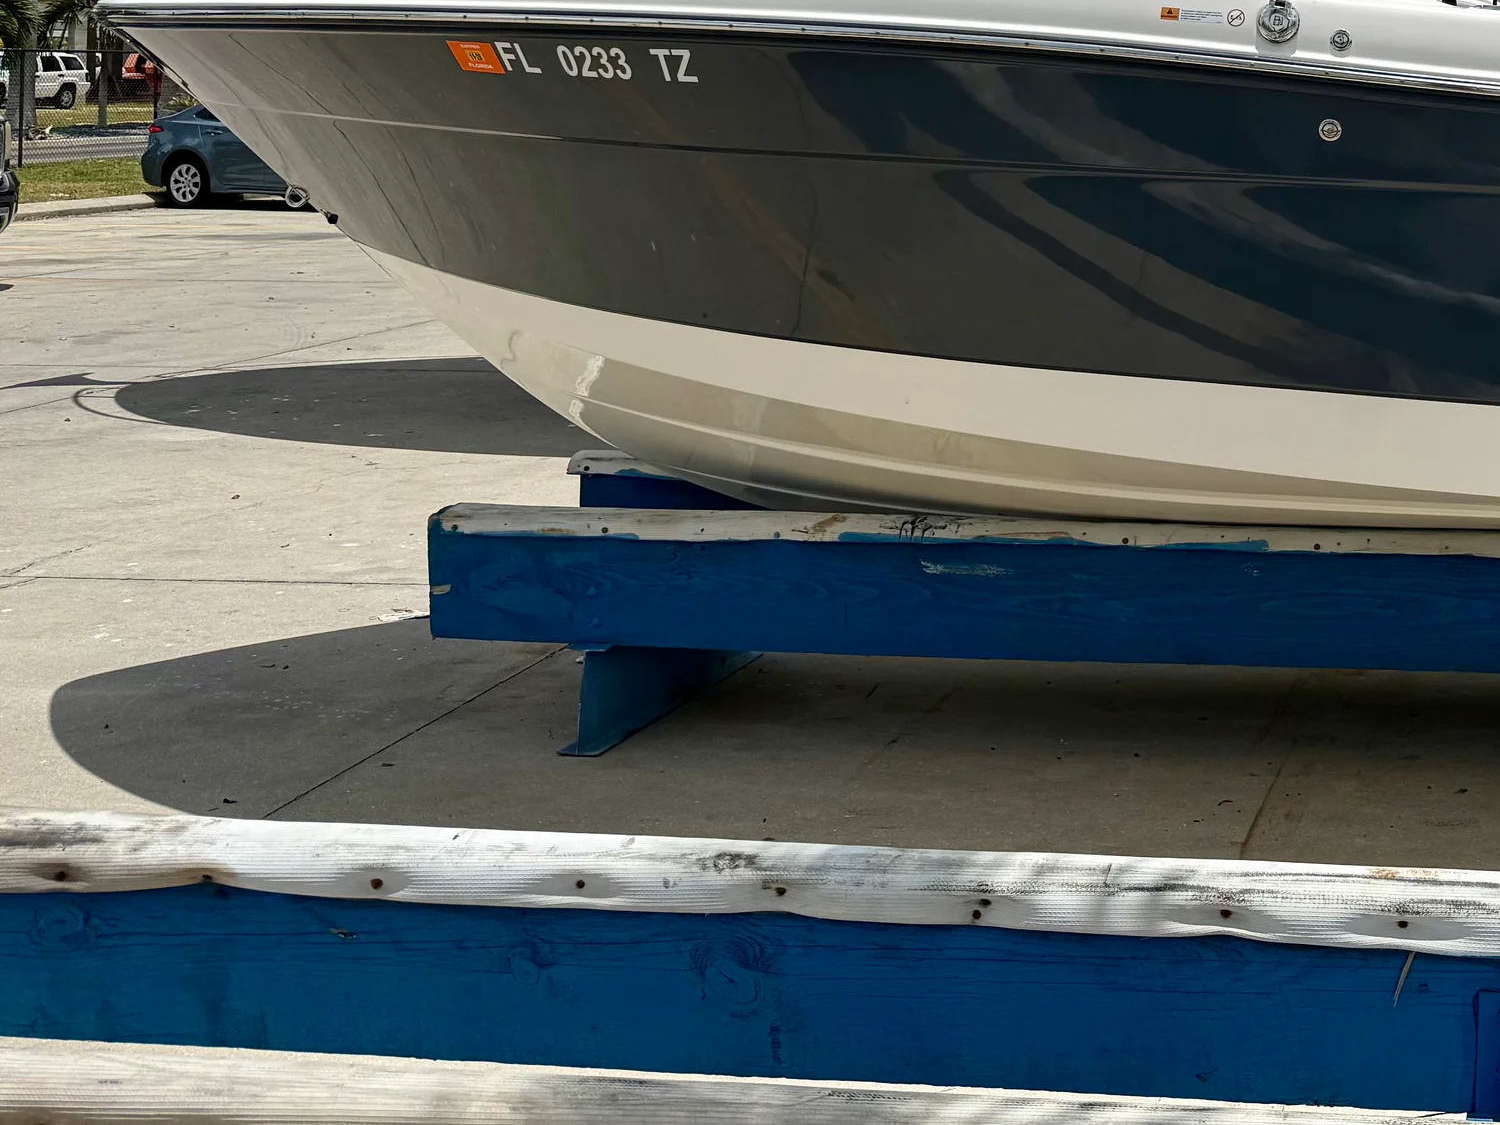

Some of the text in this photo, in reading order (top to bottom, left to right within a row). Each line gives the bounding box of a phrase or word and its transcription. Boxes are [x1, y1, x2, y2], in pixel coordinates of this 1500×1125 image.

[494, 41, 699, 83] FL 0233 TZ
